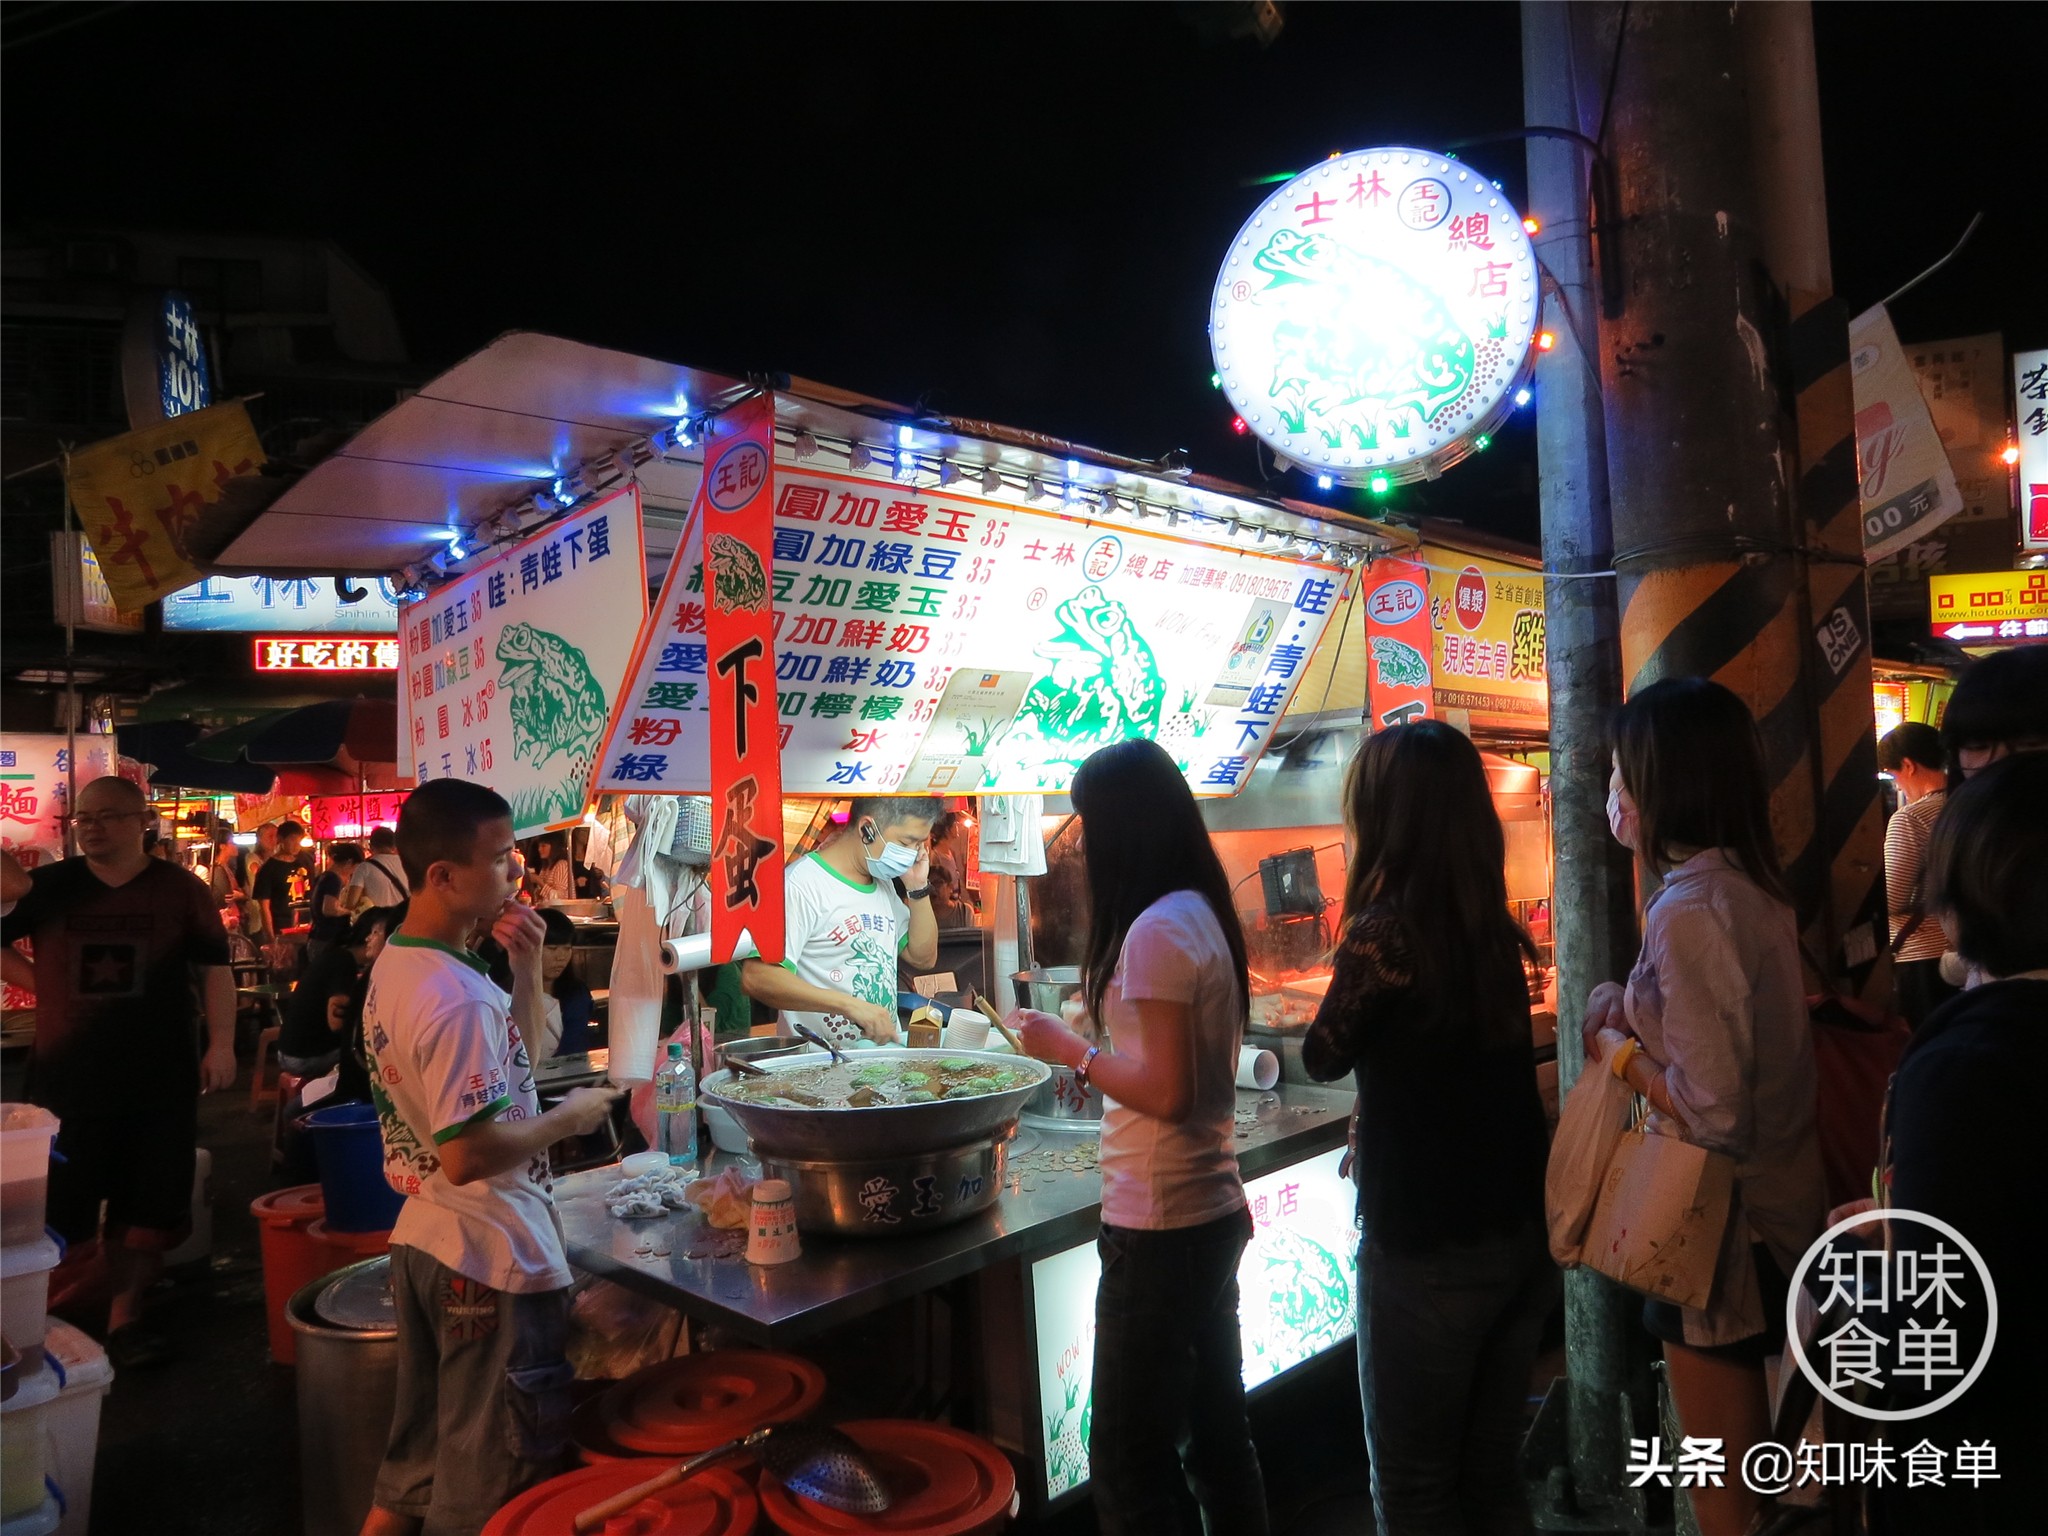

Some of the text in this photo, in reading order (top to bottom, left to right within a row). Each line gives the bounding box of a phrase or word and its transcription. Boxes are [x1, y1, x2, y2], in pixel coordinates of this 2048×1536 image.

[1294, 170, 1391, 227] 士林
[1447, 212, 1513, 299] 總店
[713, 450, 762, 499] 王記
[980, 519, 1010, 549] 35
[966, 556, 996, 585] 35
[1023, 538, 1076, 568] 士林
[1087, 542, 1117, 576] 王記
[1122, 553, 1175, 582] 總店
[335, 609, 380, 619] Shihlin
[470, 591, 483, 623] 35
[1374, 589, 1417, 616] 王記
[1825, 612, 1849, 648] JS
[473, 636, 485, 670] 35
[923, 665, 953, 692] 35
[477, 689, 489, 723] 35
[908, 698, 939, 724] 35
[480, 737, 493, 771] 35
[714, 637, 777, 908] 下蛋
